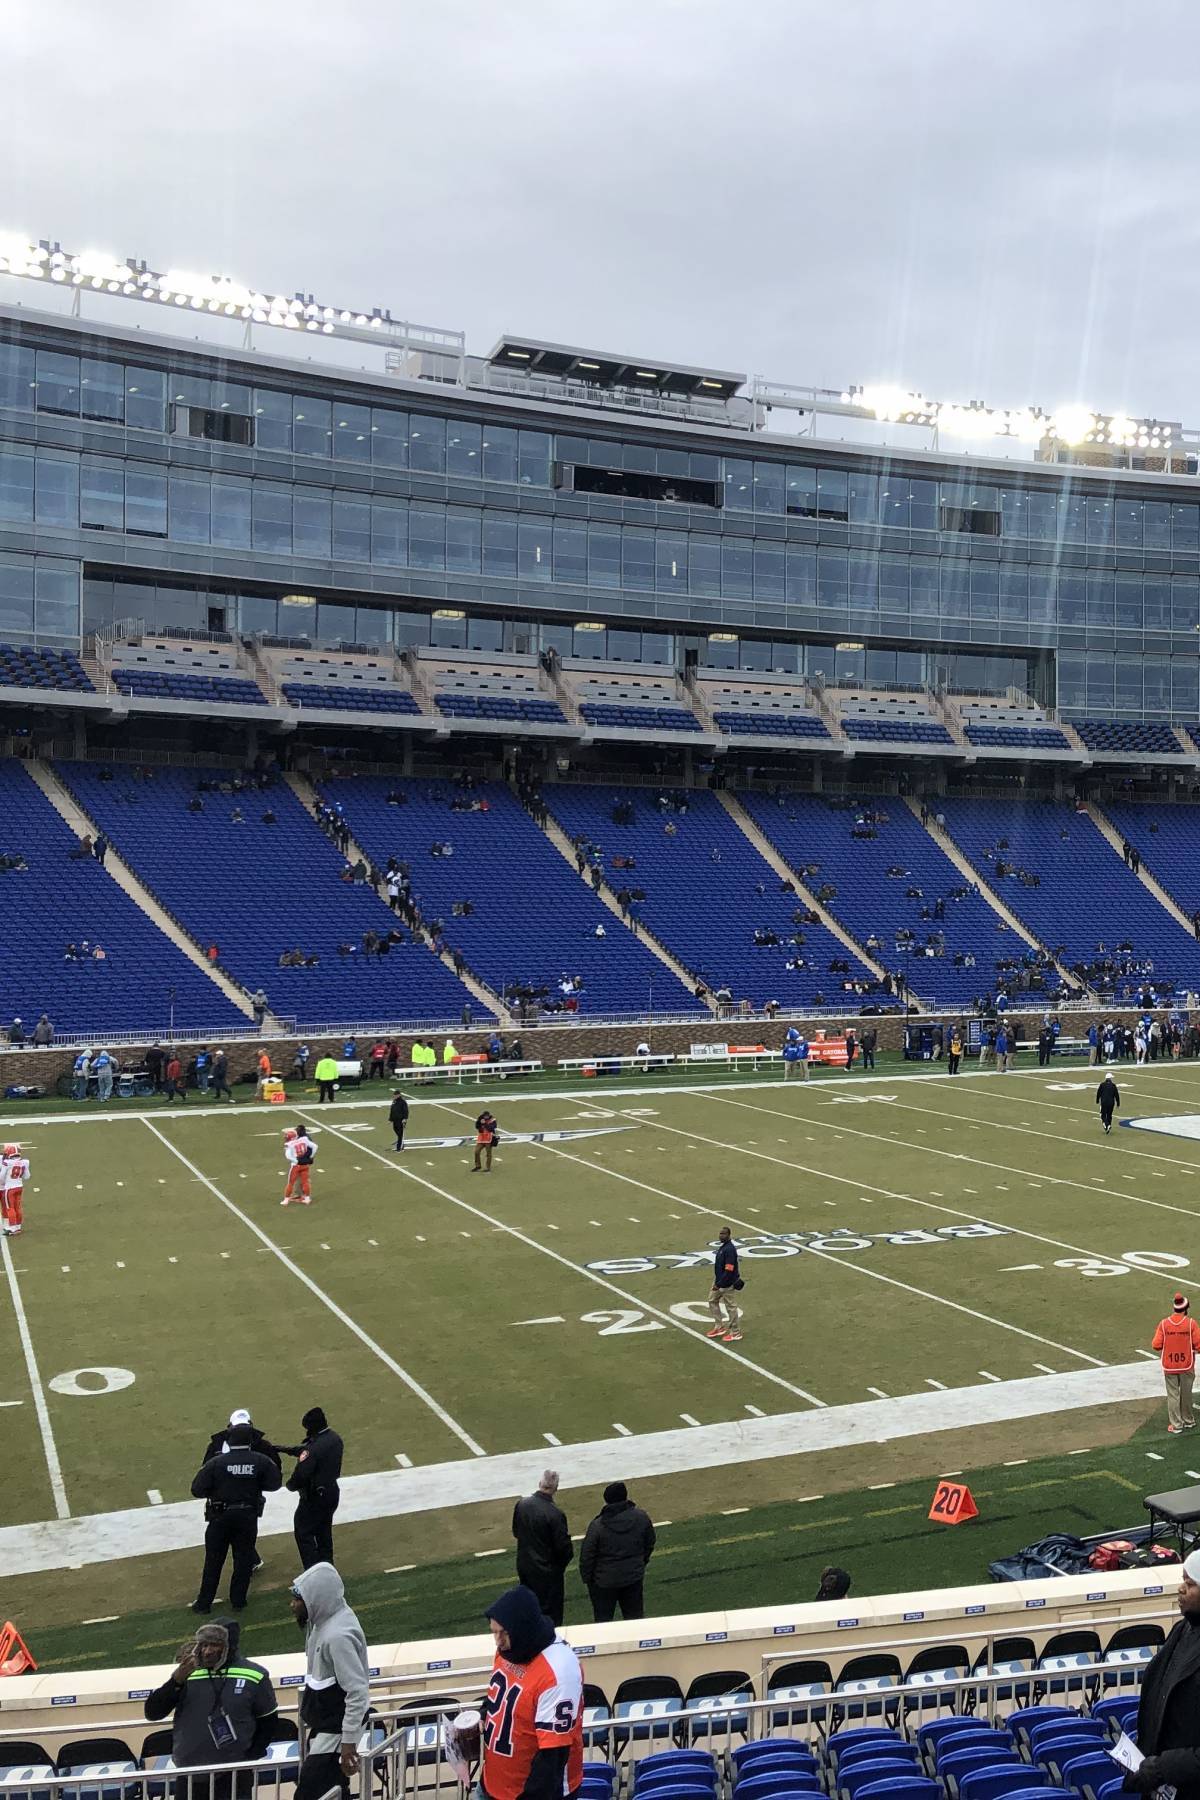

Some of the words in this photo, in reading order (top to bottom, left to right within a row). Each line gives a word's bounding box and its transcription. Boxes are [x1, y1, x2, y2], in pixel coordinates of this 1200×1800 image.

[583, 1223, 1014, 1276] BROOKS
[1053, 1251, 1190, 1276] 30
[580, 1301, 744, 1336] 20
[1168, 1352, 1186, 1363] 105
[227, 1463, 255, 1476] POLICE
[934, 1486, 961, 1515] 20
[484, 1669, 524, 1758] 21
[552, 1700, 576, 1735] S
